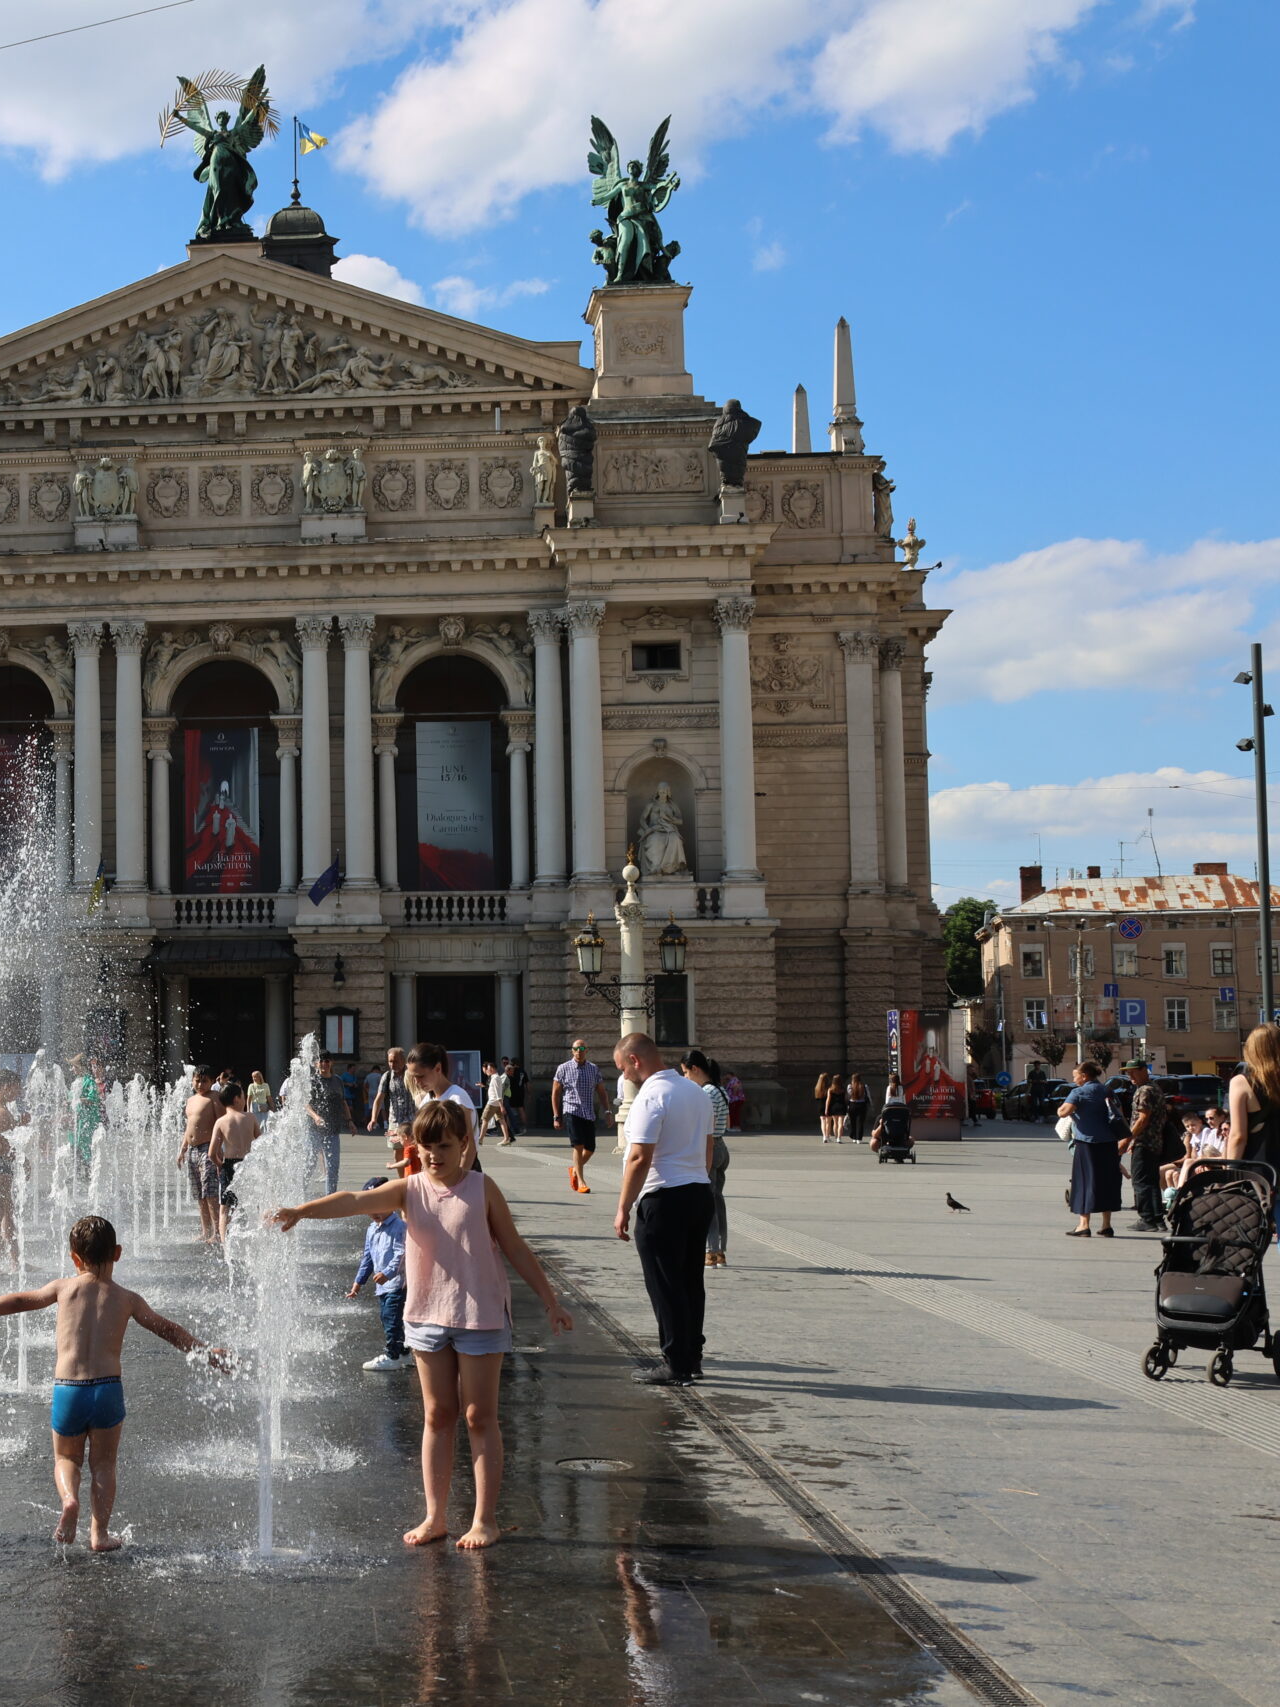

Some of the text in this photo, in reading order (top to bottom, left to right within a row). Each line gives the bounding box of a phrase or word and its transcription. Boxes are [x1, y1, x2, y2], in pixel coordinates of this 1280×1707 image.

[441, 764, 465, 773] JUNE
[441, 774, 468, 782] 15/16
[426, 812, 467, 823] Dialogues
[1125, 1002, 1141, 1022] P
